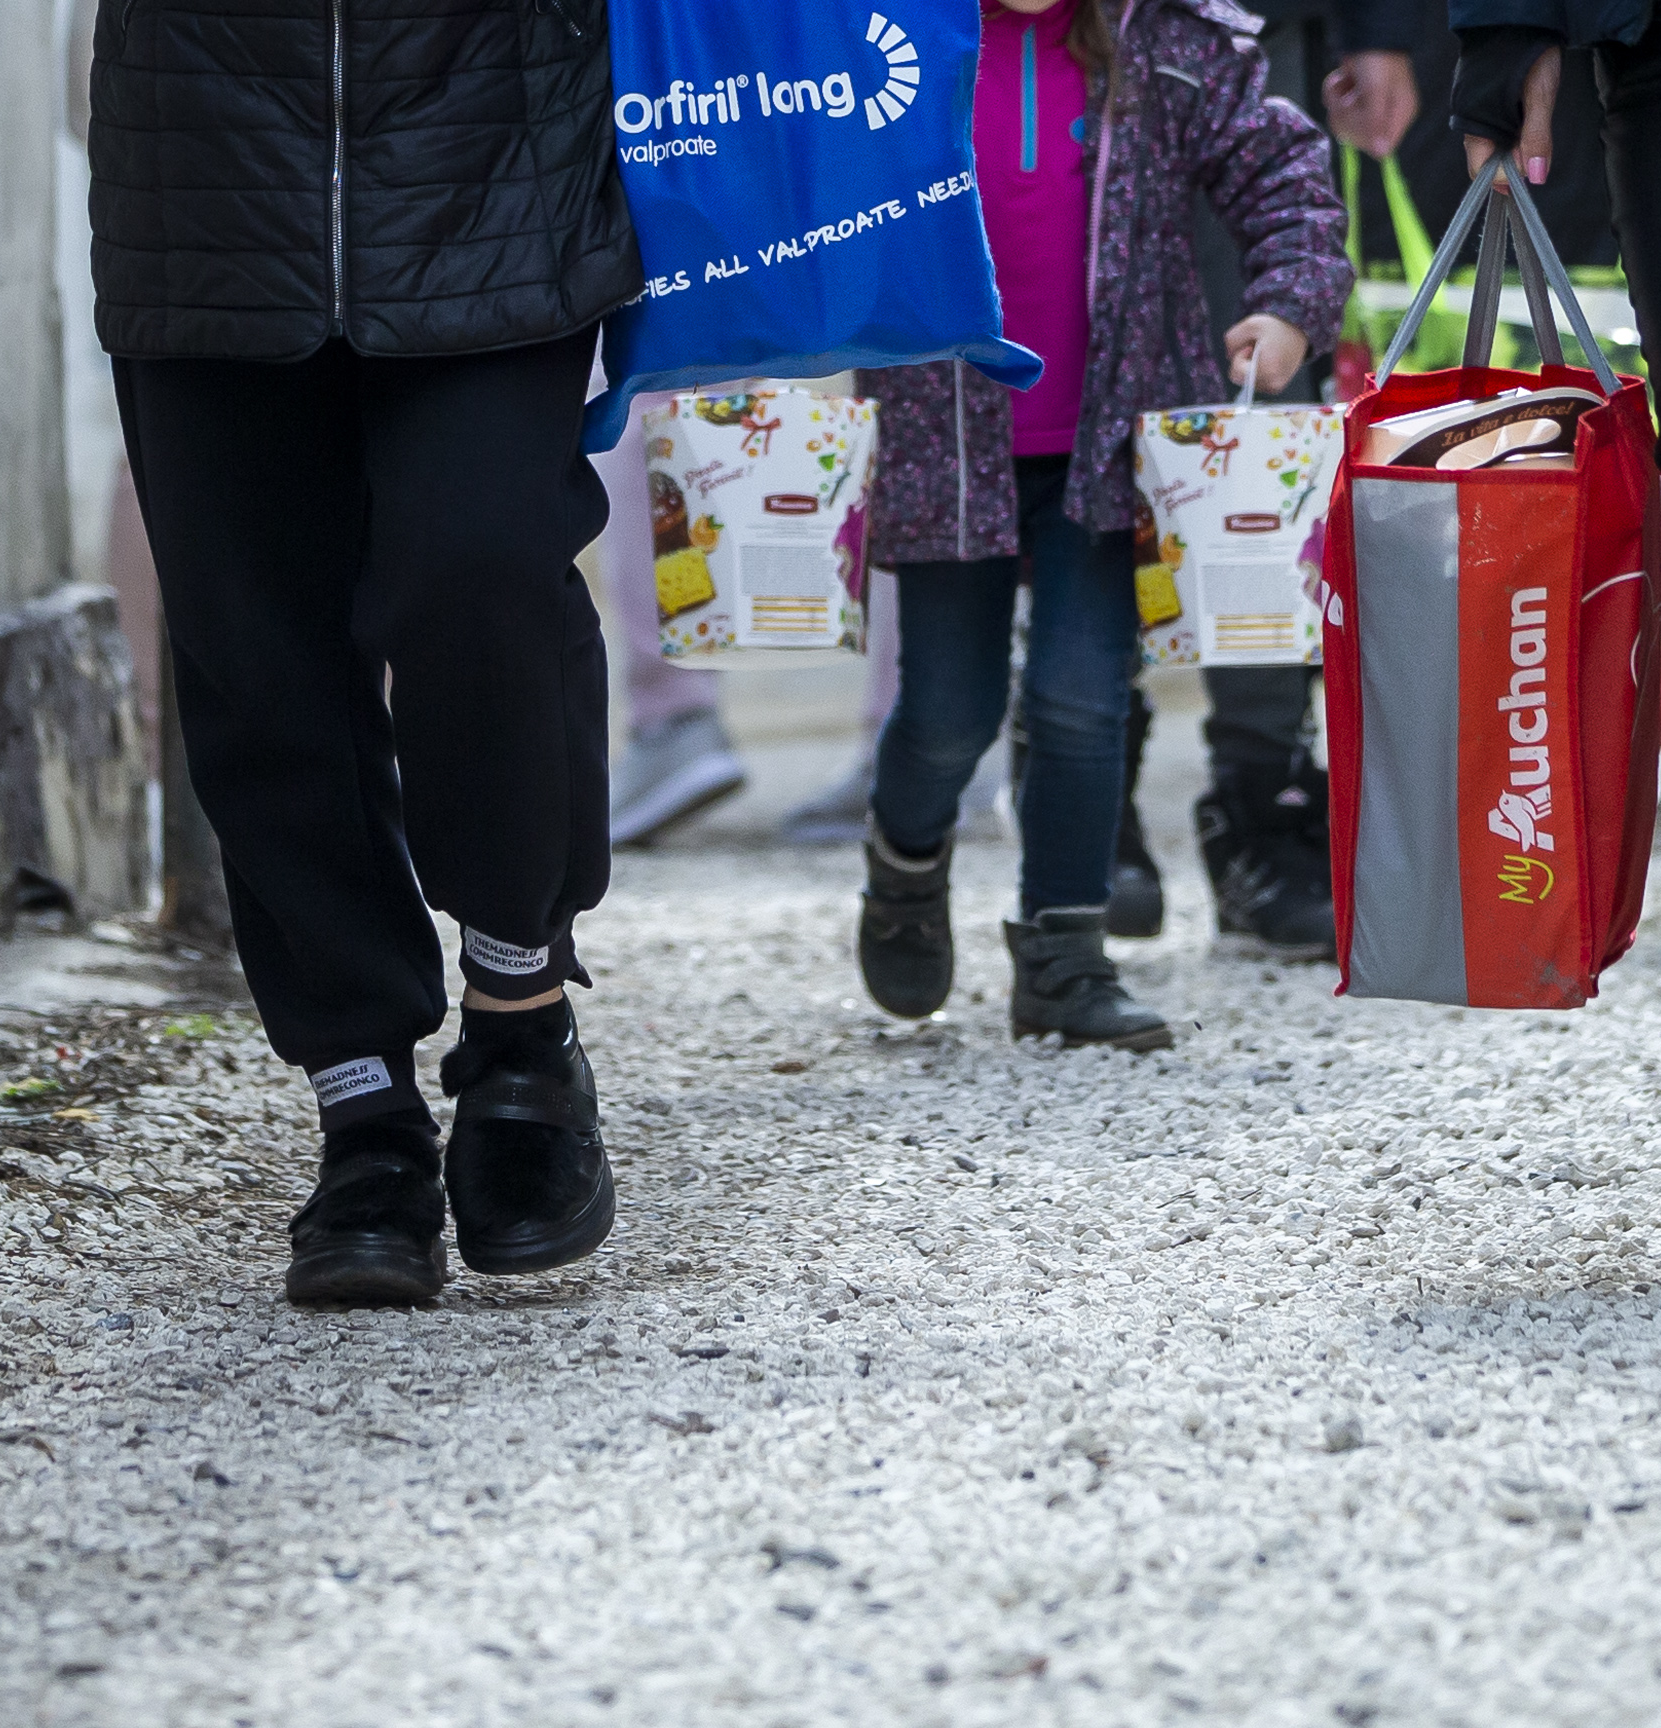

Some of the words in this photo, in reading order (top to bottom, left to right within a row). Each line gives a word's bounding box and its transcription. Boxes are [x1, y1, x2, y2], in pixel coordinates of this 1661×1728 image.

[755, 71, 856, 118] long
[620, 134, 718, 167] valproate
[704, 254, 750, 283] ALL
[757, 199, 907, 267] VALPROATE
[1517, 400, 1576, 421] dolce!
[1487, 586, 1555, 853] Auchan
[1497, 854, 1555, 905] My
[474, 935, 538, 959] THEMADNESS
